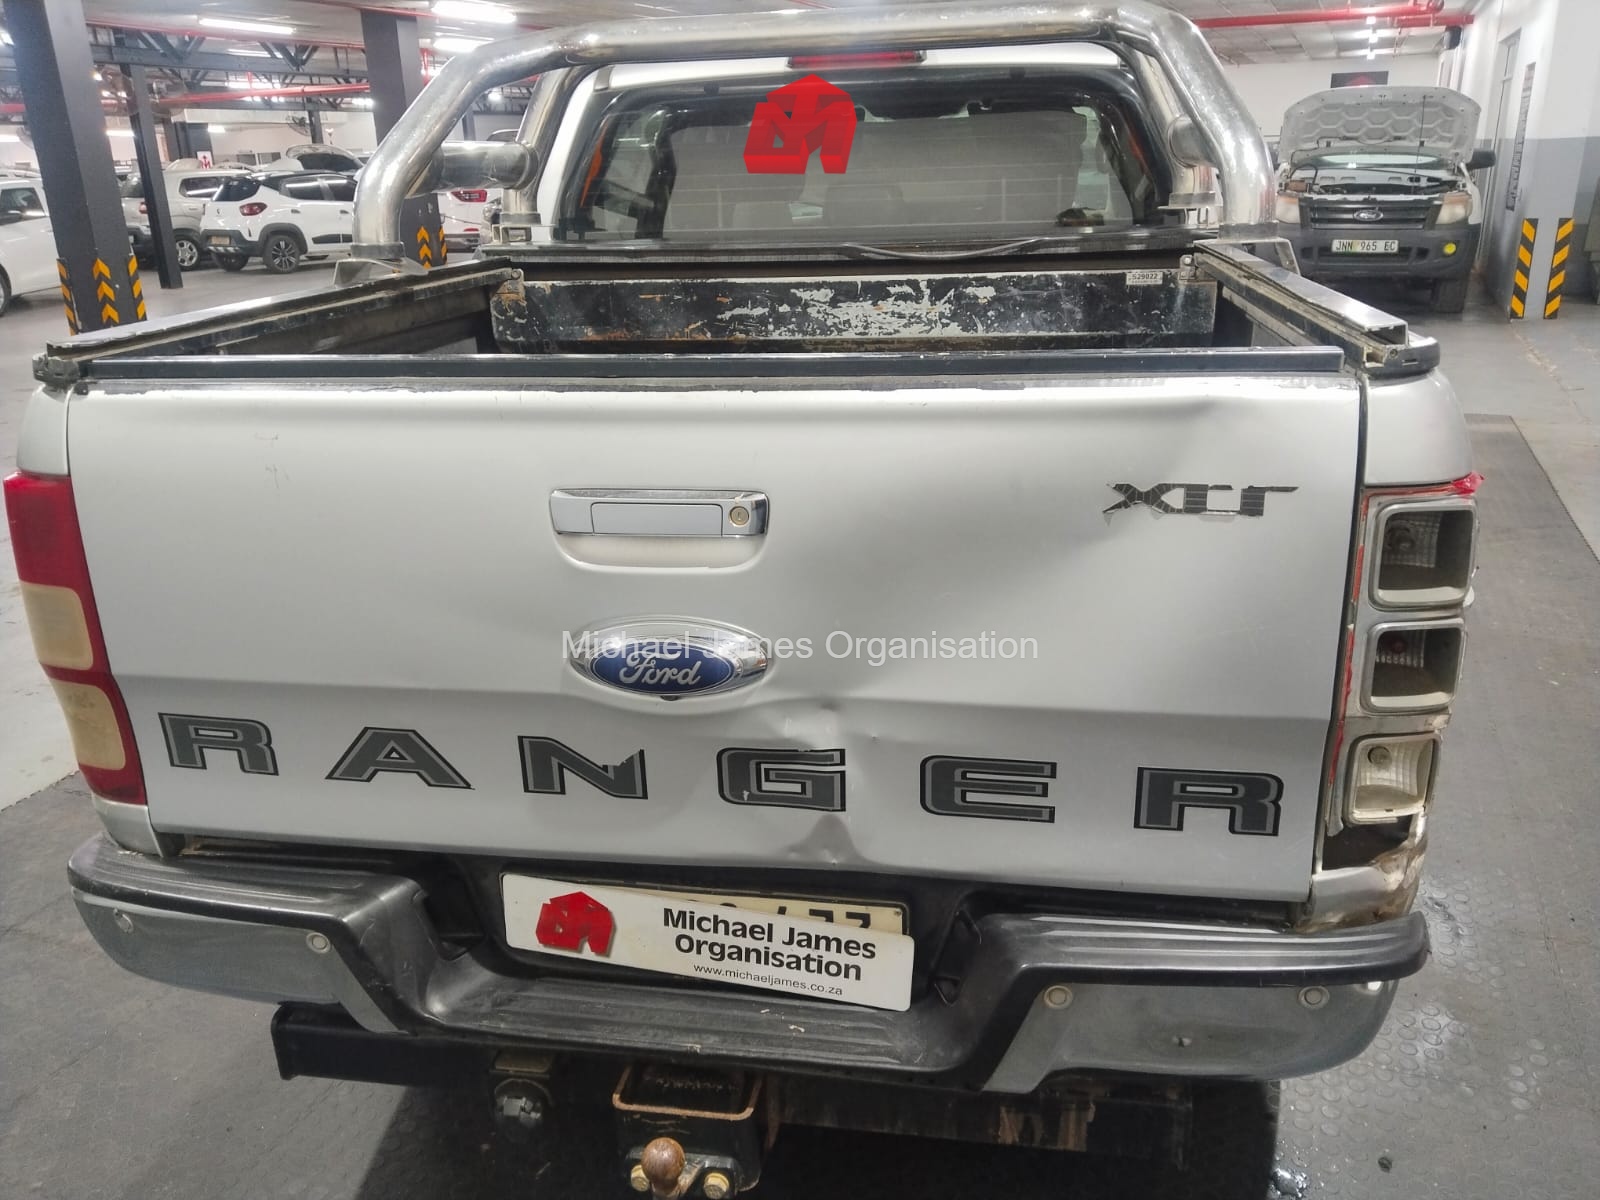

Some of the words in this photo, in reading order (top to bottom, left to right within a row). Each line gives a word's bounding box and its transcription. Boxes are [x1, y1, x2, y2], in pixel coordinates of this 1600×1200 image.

[1335, 241, 1353, 251] JNN
[1360, 241, 1377, 251] 965
[1384, 241, 1396, 251] EC
[618, 653, 701, 686] Ford
[158, 712, 1285, 837] RANGER
[663, 907, 774, 943] Michael
[782, 926, 877, 960] James
[675, 933, 862, 982] Organisation
[693, 963, 843, 996] www.michaeljames.co.za
